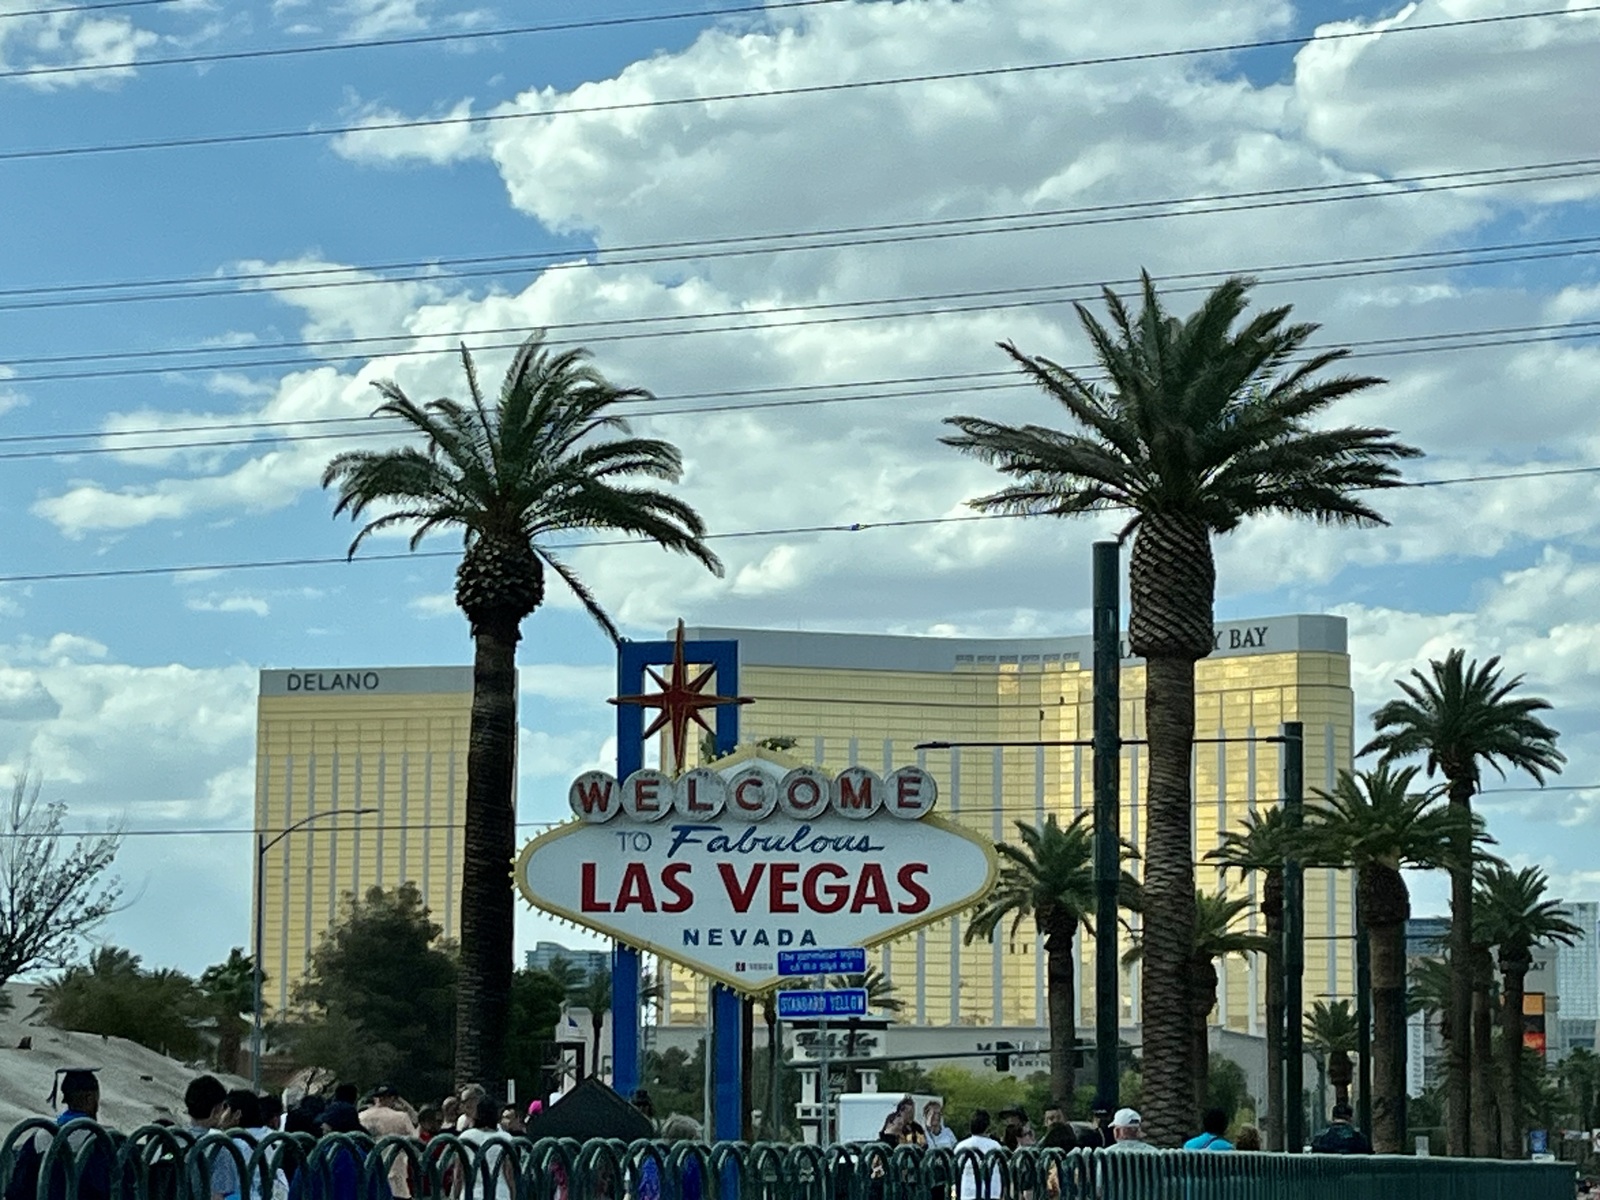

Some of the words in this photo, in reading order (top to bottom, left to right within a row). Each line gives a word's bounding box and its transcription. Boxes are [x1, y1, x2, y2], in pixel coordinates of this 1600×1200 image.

[1229, 626, 1269, 650] BAY
[287, 671, 380, 692] DELANO
[576, 775, 923, 813] WELCOME
[616, 831, 652, 853] TO
[667, 824, 885, 858] Fabulous
[580, 862, 694, 914] LAS
[717, 862, 931, 914] VEGAS
[683, 927, 818, 947] NEVADA
